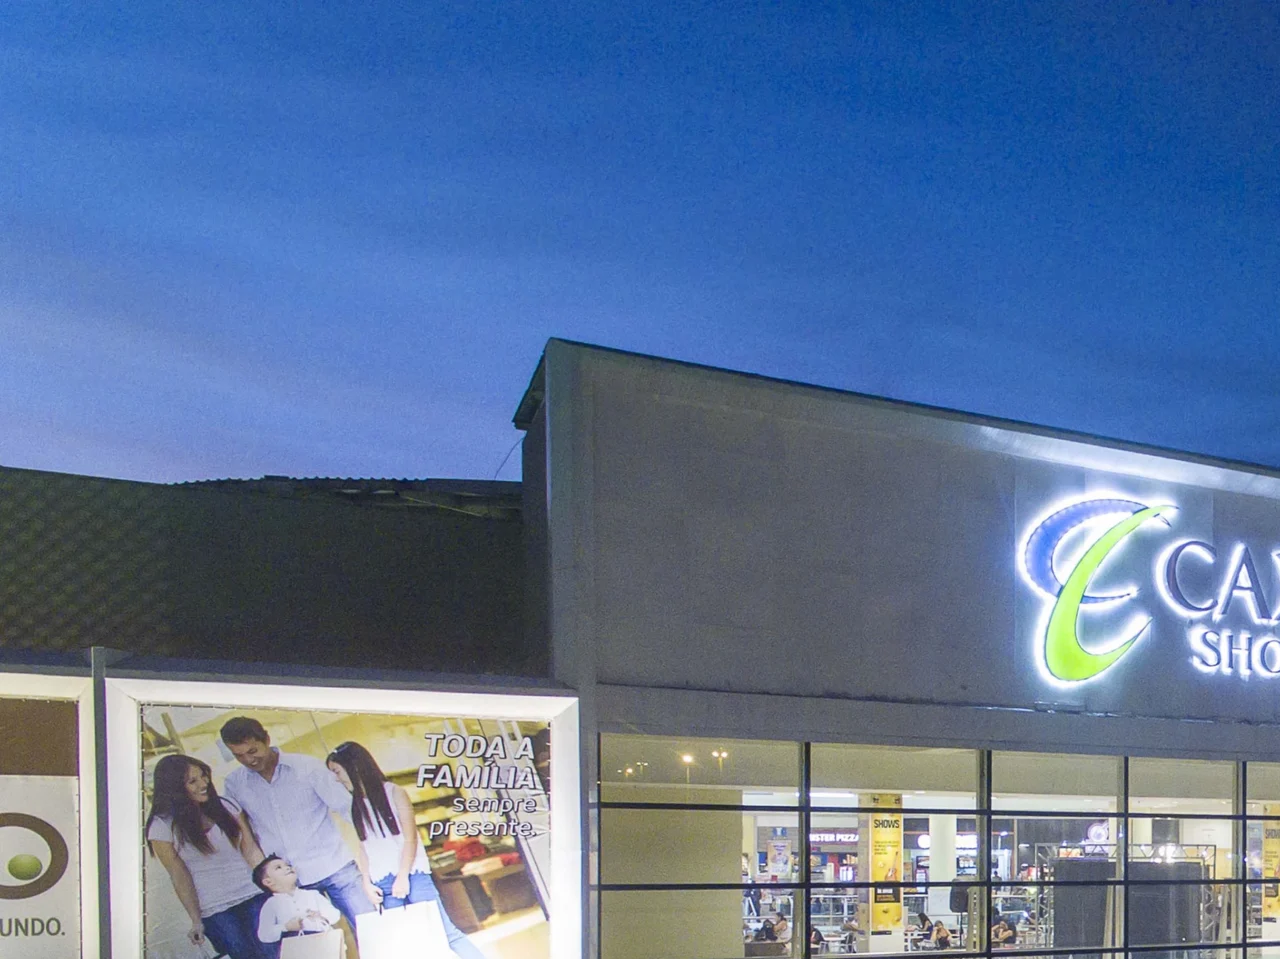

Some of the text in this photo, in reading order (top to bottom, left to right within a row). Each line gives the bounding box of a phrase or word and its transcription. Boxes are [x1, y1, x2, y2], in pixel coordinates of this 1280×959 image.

[425, 733, 535, 760] TODA A
[416, 760, 537, 789] FAMÍLIA
[453, 797, 537, 817] sempre
[429, 818, 537, 839] presente.
[873, 819, 900, 829] SHOWS
